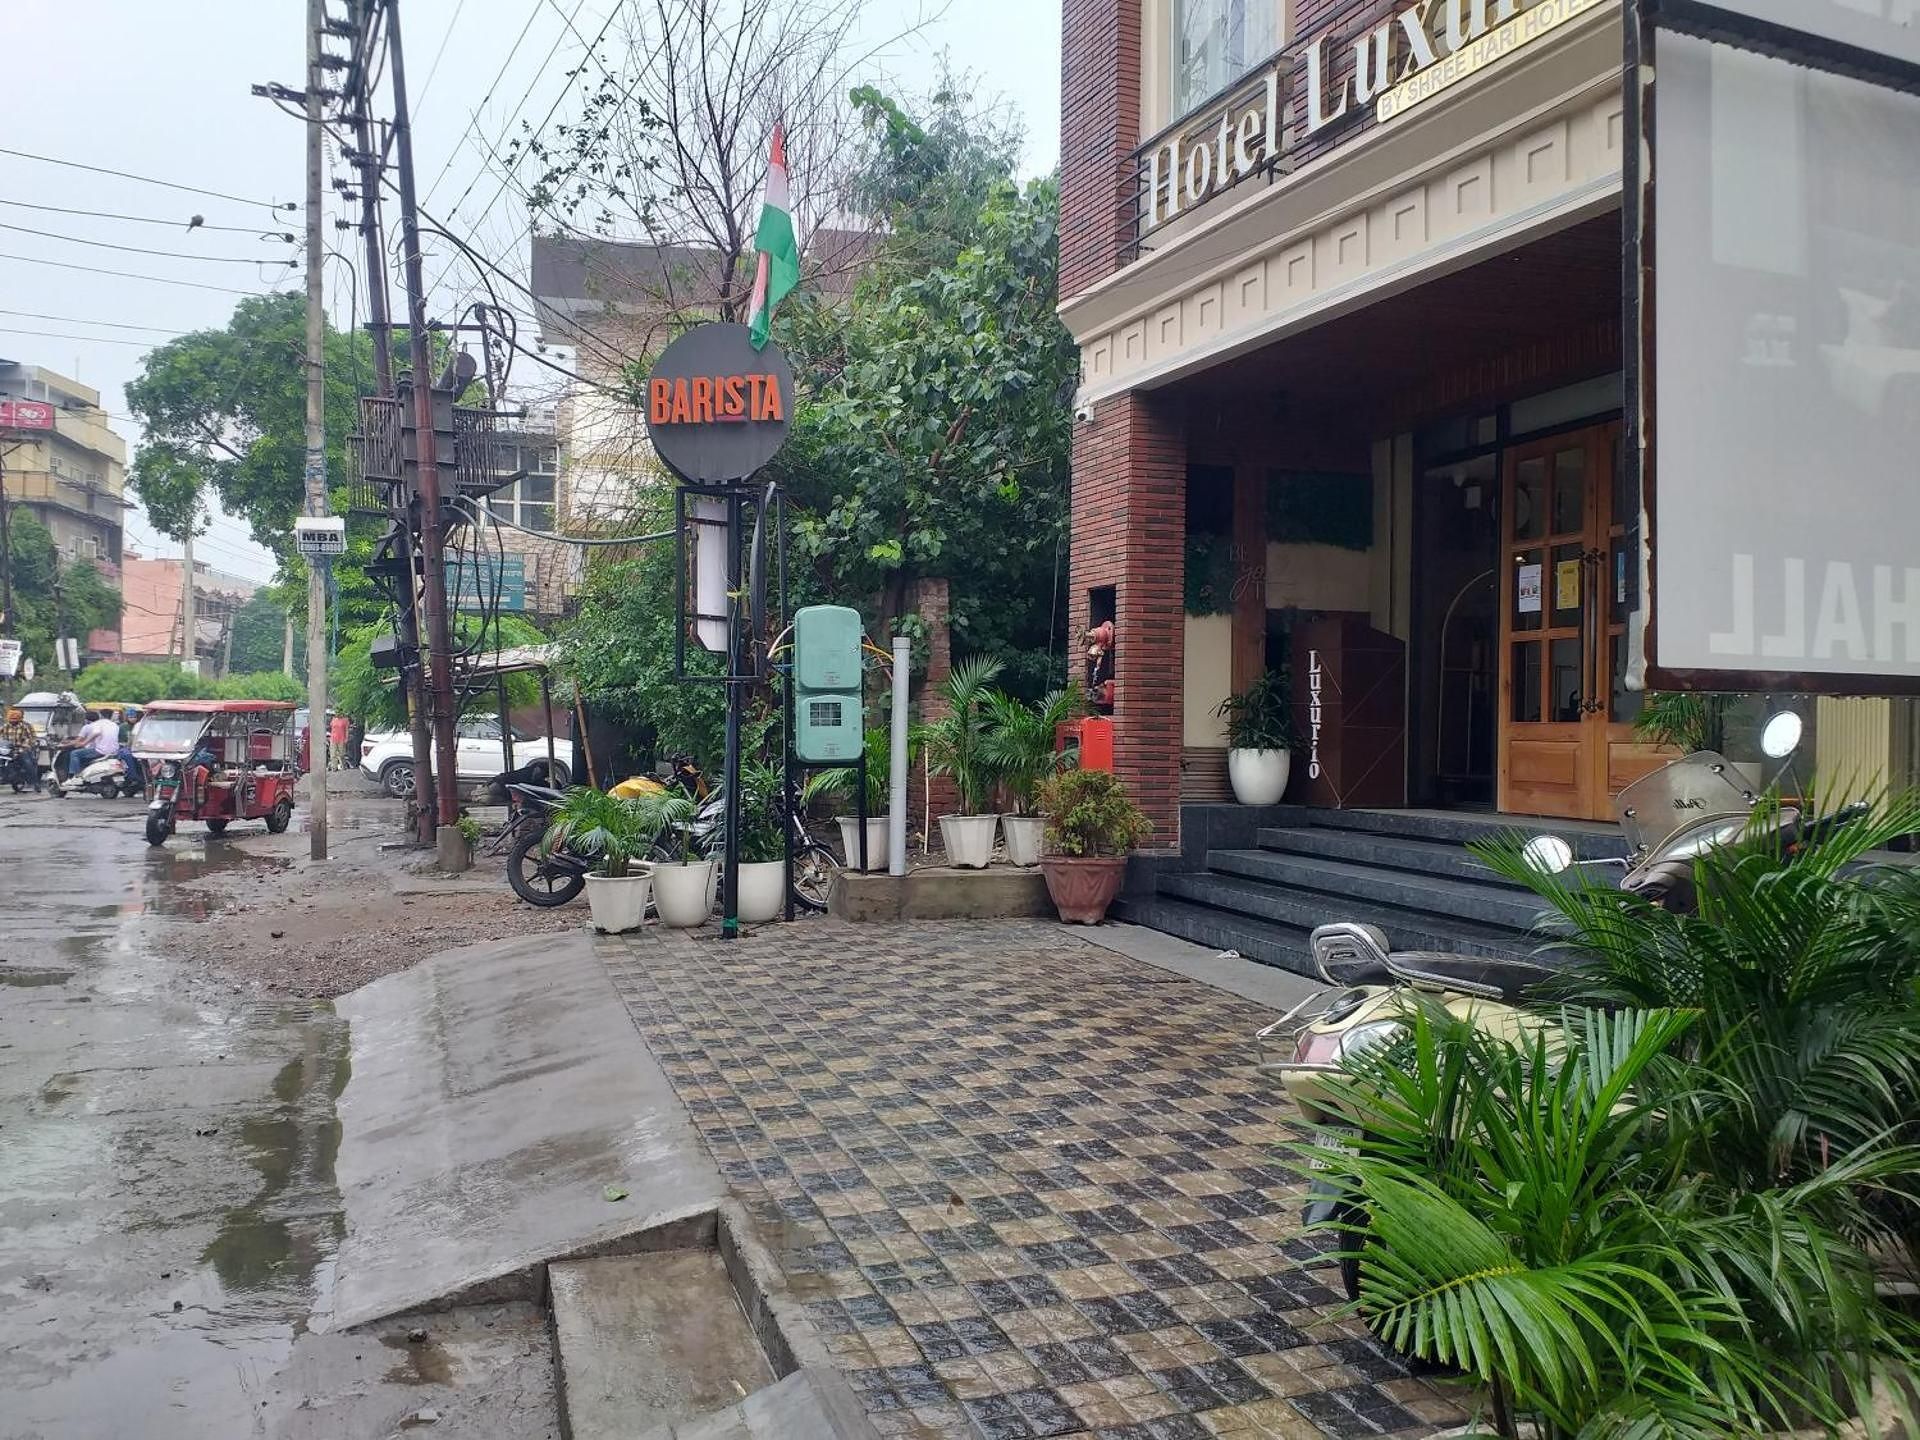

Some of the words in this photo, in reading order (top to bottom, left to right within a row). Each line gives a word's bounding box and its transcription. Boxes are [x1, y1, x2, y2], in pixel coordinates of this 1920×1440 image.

[1382, 85, 1404, 118] BY
[1407, 51, 1468, 101] SHREE
[1472, 22, 1518, 68] HARI
[1524, 0, 1591, 38] HOTE
[1150, 68, 1280, 229] Hotel
[650, 374, 784, 424] BARISTA
[302, 532, 339, 542] MBA
[1308, 649, 1322, 780] Luxurio
